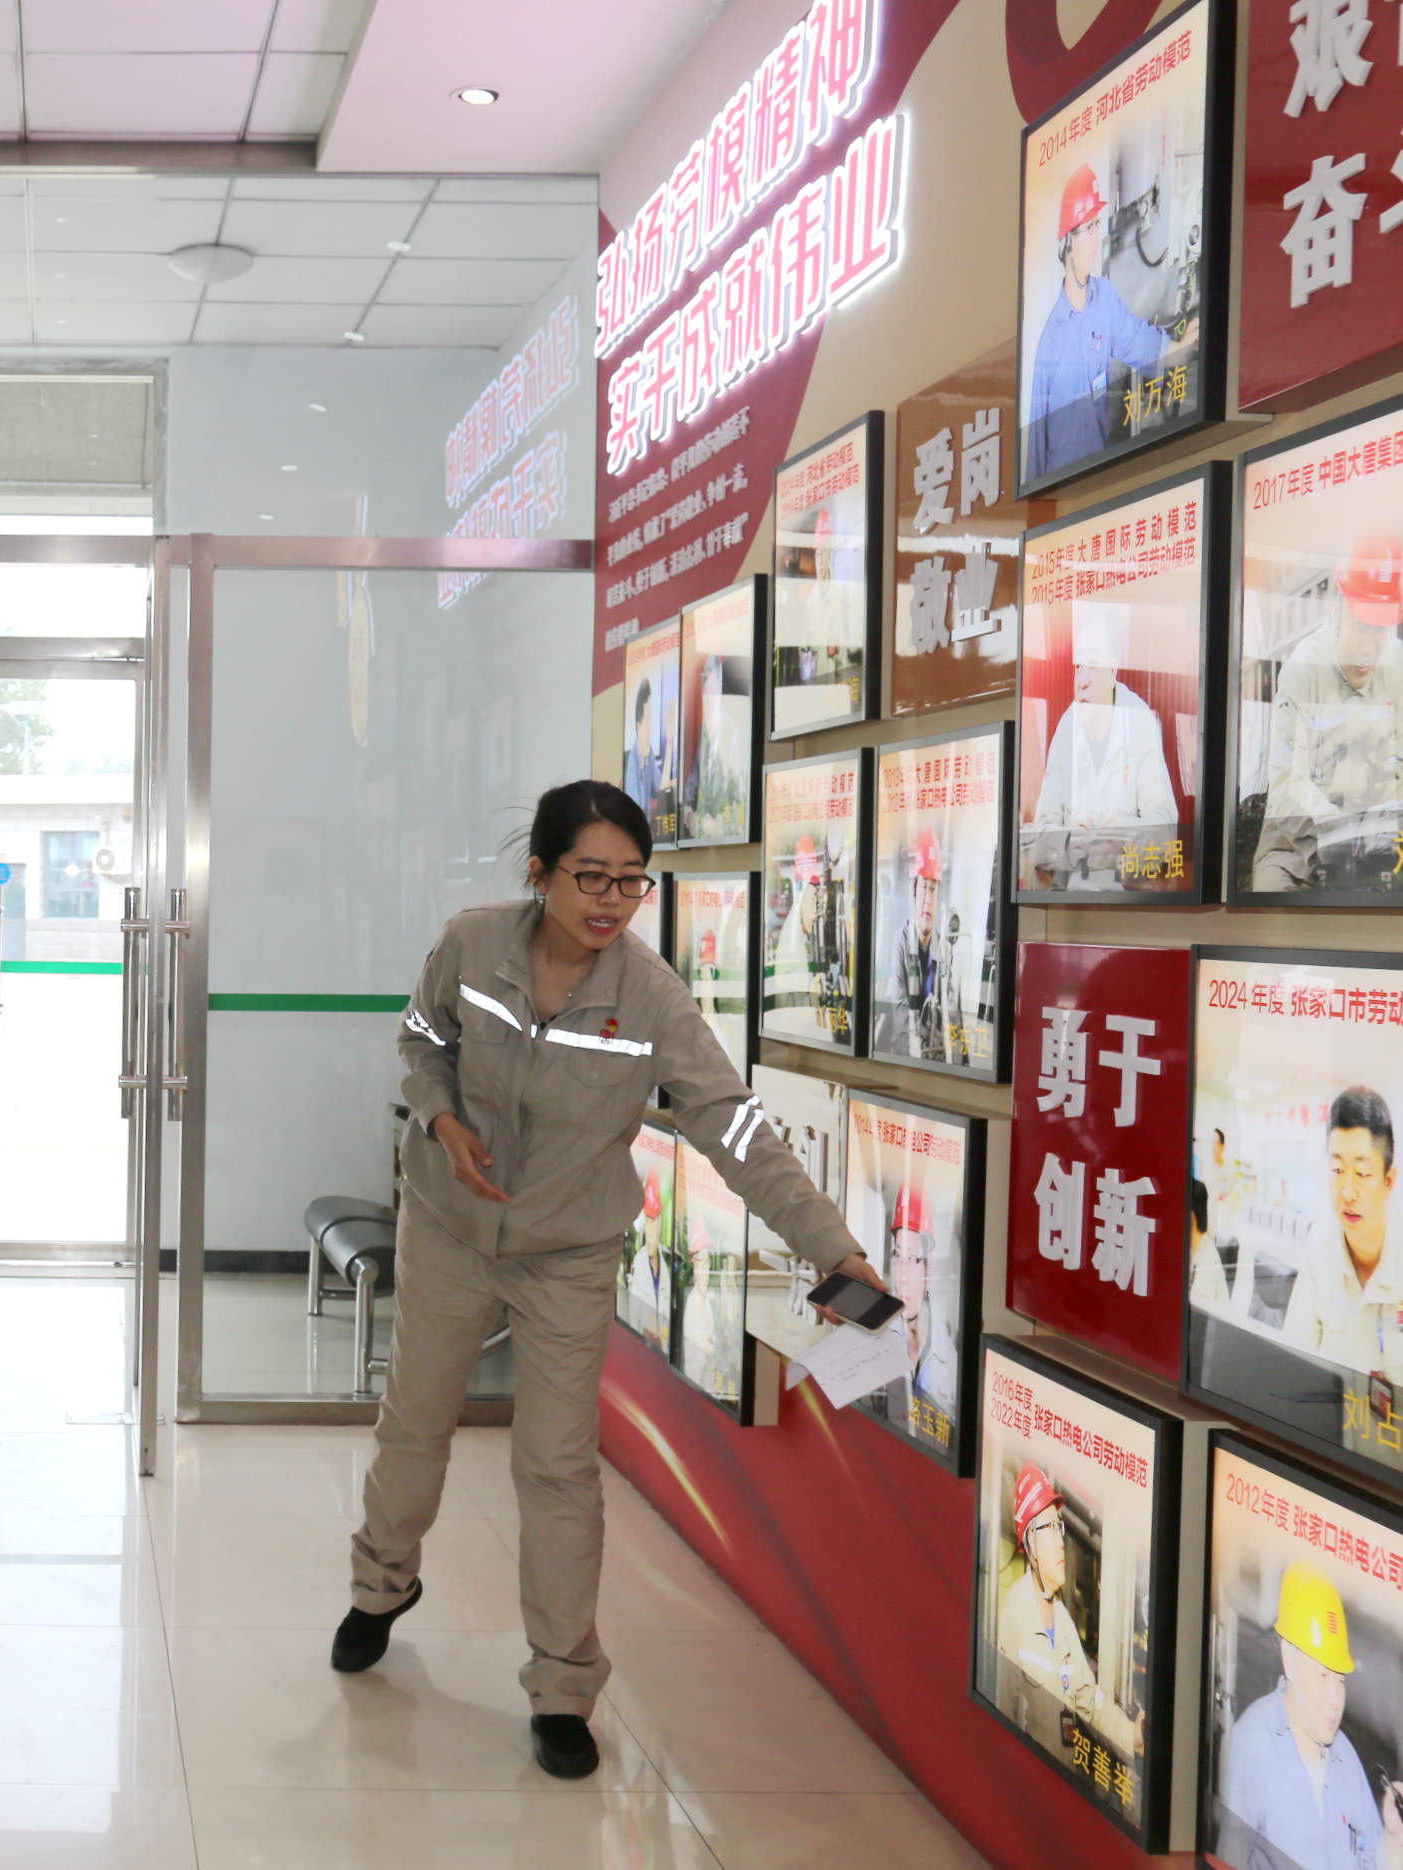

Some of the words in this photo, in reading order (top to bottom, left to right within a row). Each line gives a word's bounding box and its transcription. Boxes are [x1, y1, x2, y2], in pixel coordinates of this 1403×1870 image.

[1038, 105, 1094, 168] 2014年度
[1095, 29, 1192, 128] 河北省劳动模范
[1283, 0, 1403, 118] 艰
[596, 0, 880, 358] 弘扬劳模精神
[607, 113, 908, 476] 实干成就伟业
[1123, 365, 1188, 427] 刘万海
[913, 408, 1000, 534] 爱岗
[1253, 465, 1315, 511] 2017年度
[1032, 574, 1074, 606] 2015年度
[1076, 536, 1196, 597] 张家口热电公司劳动模范
[1077, 501, 1197, 564] 大唐国际劳动模范
[910, 542, 1000, 655] 敬业
[1120, 839, 1184, 880] 尚志强
[1209, 979, 1285, 1015] 2024年度
[1036, 1006, 1162, 1128] 勇于
[1034, 1152, 1158, 1297] 创新
[993, 1372, 1033, 1412] 2016年度
[991, 1398, 1031, 1440] 2022年度
[1034, 1404, 1148, 1489] 张家口热电公司劳动模范
[1226, 1473, 1290, 1531] 2012年度
[1293, 1504, 1403, 1591] 张家口热电公司
[1072, 1728, 1134, 1805] 贺善举
